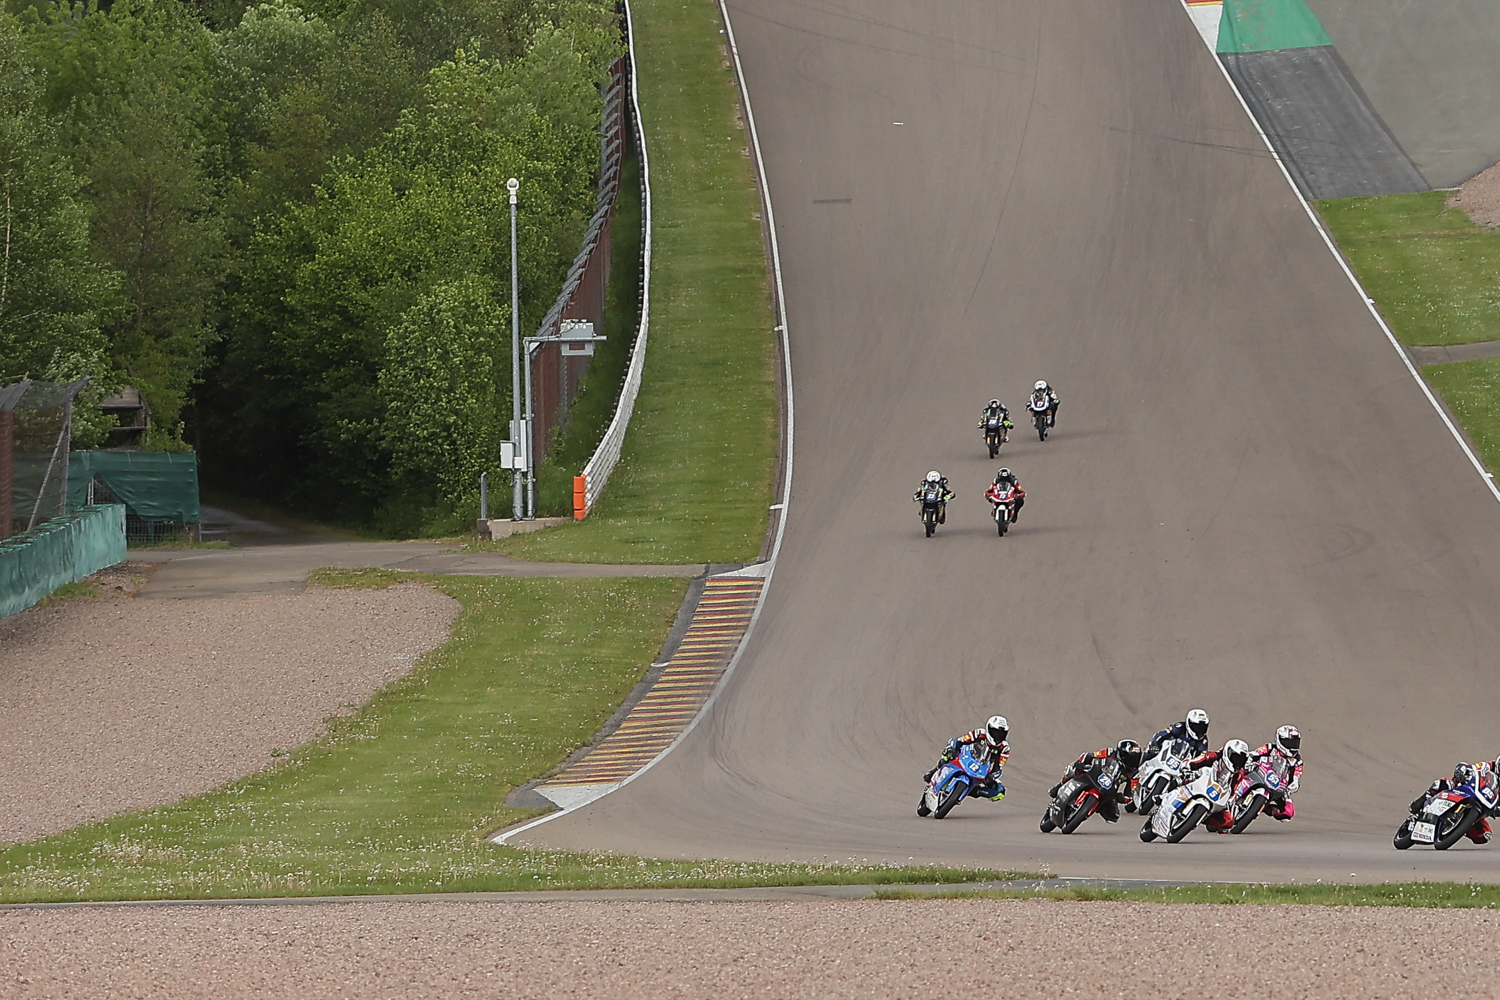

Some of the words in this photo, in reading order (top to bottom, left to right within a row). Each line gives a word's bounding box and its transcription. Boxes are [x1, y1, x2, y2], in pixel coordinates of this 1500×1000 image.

[968, 762, 980, 772] 12
[1167, 757, 1180, 768] 95
[1099, 776, 1112, 787] 26
